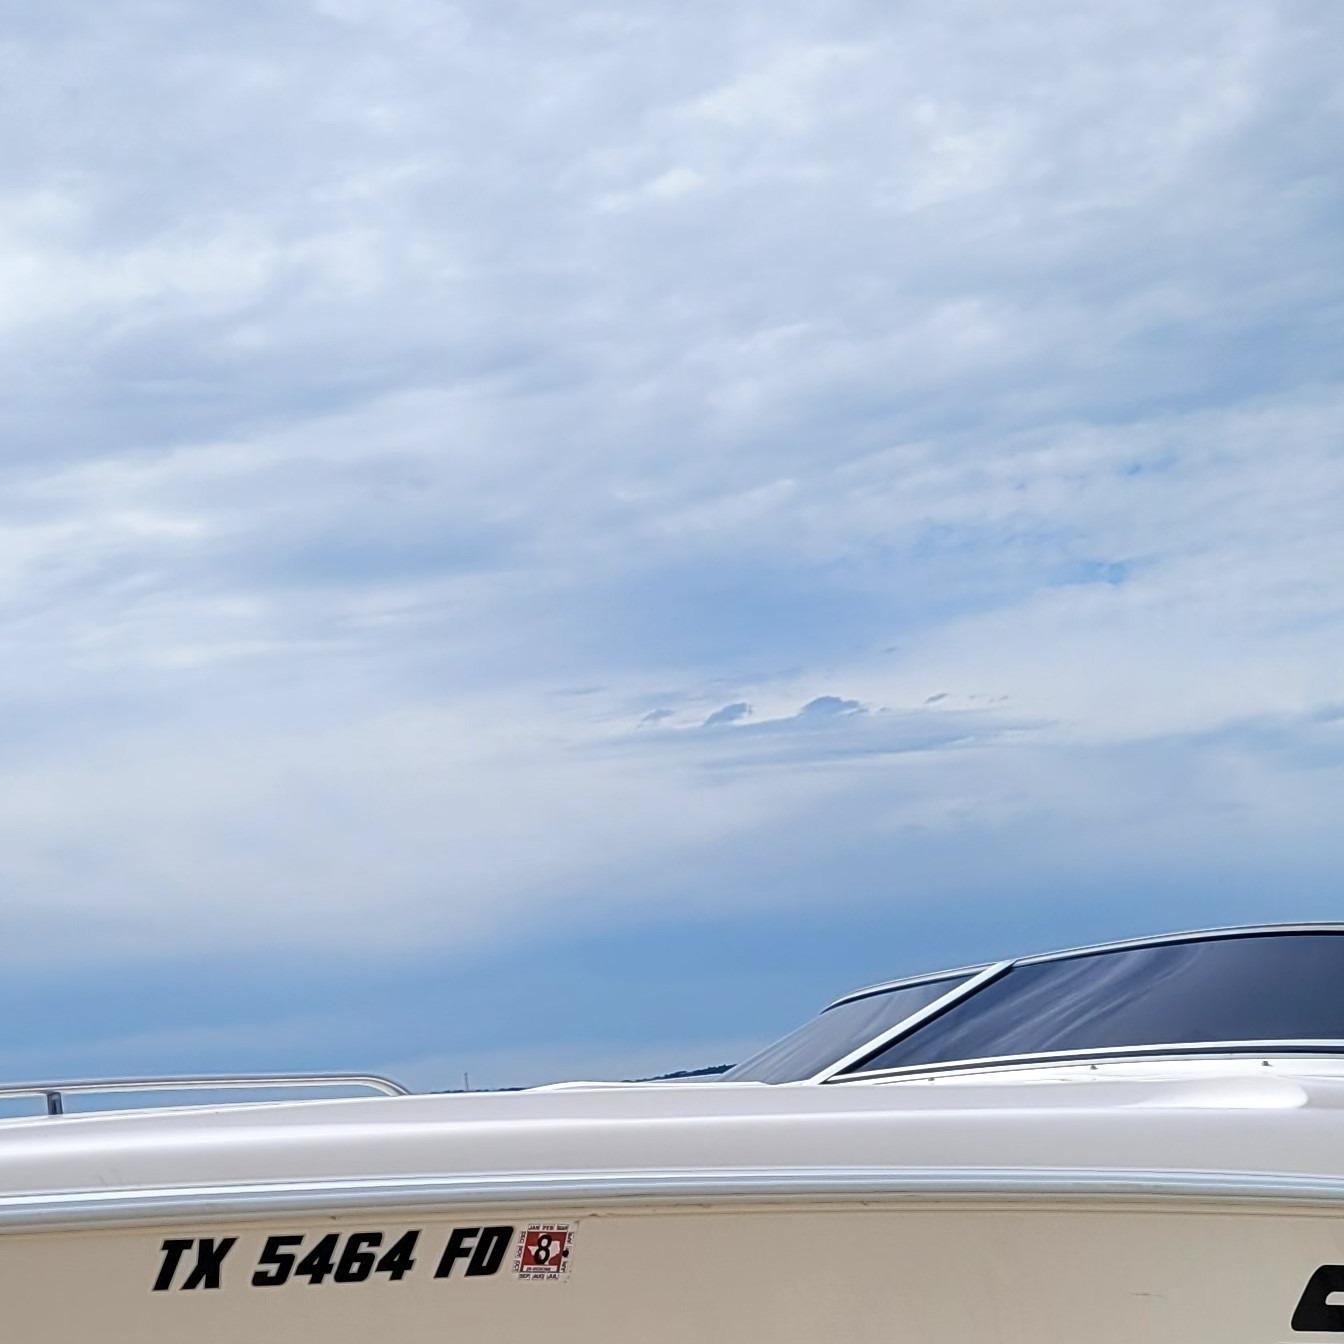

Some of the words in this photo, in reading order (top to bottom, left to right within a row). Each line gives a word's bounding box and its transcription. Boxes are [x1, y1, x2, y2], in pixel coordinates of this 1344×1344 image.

[152, 1237, 239, 1291] TX
[251, 1229, 422, 1287] 5464
[433, 1226, 515, 1279] FD
[534, 1234, 553, 1265] 8
